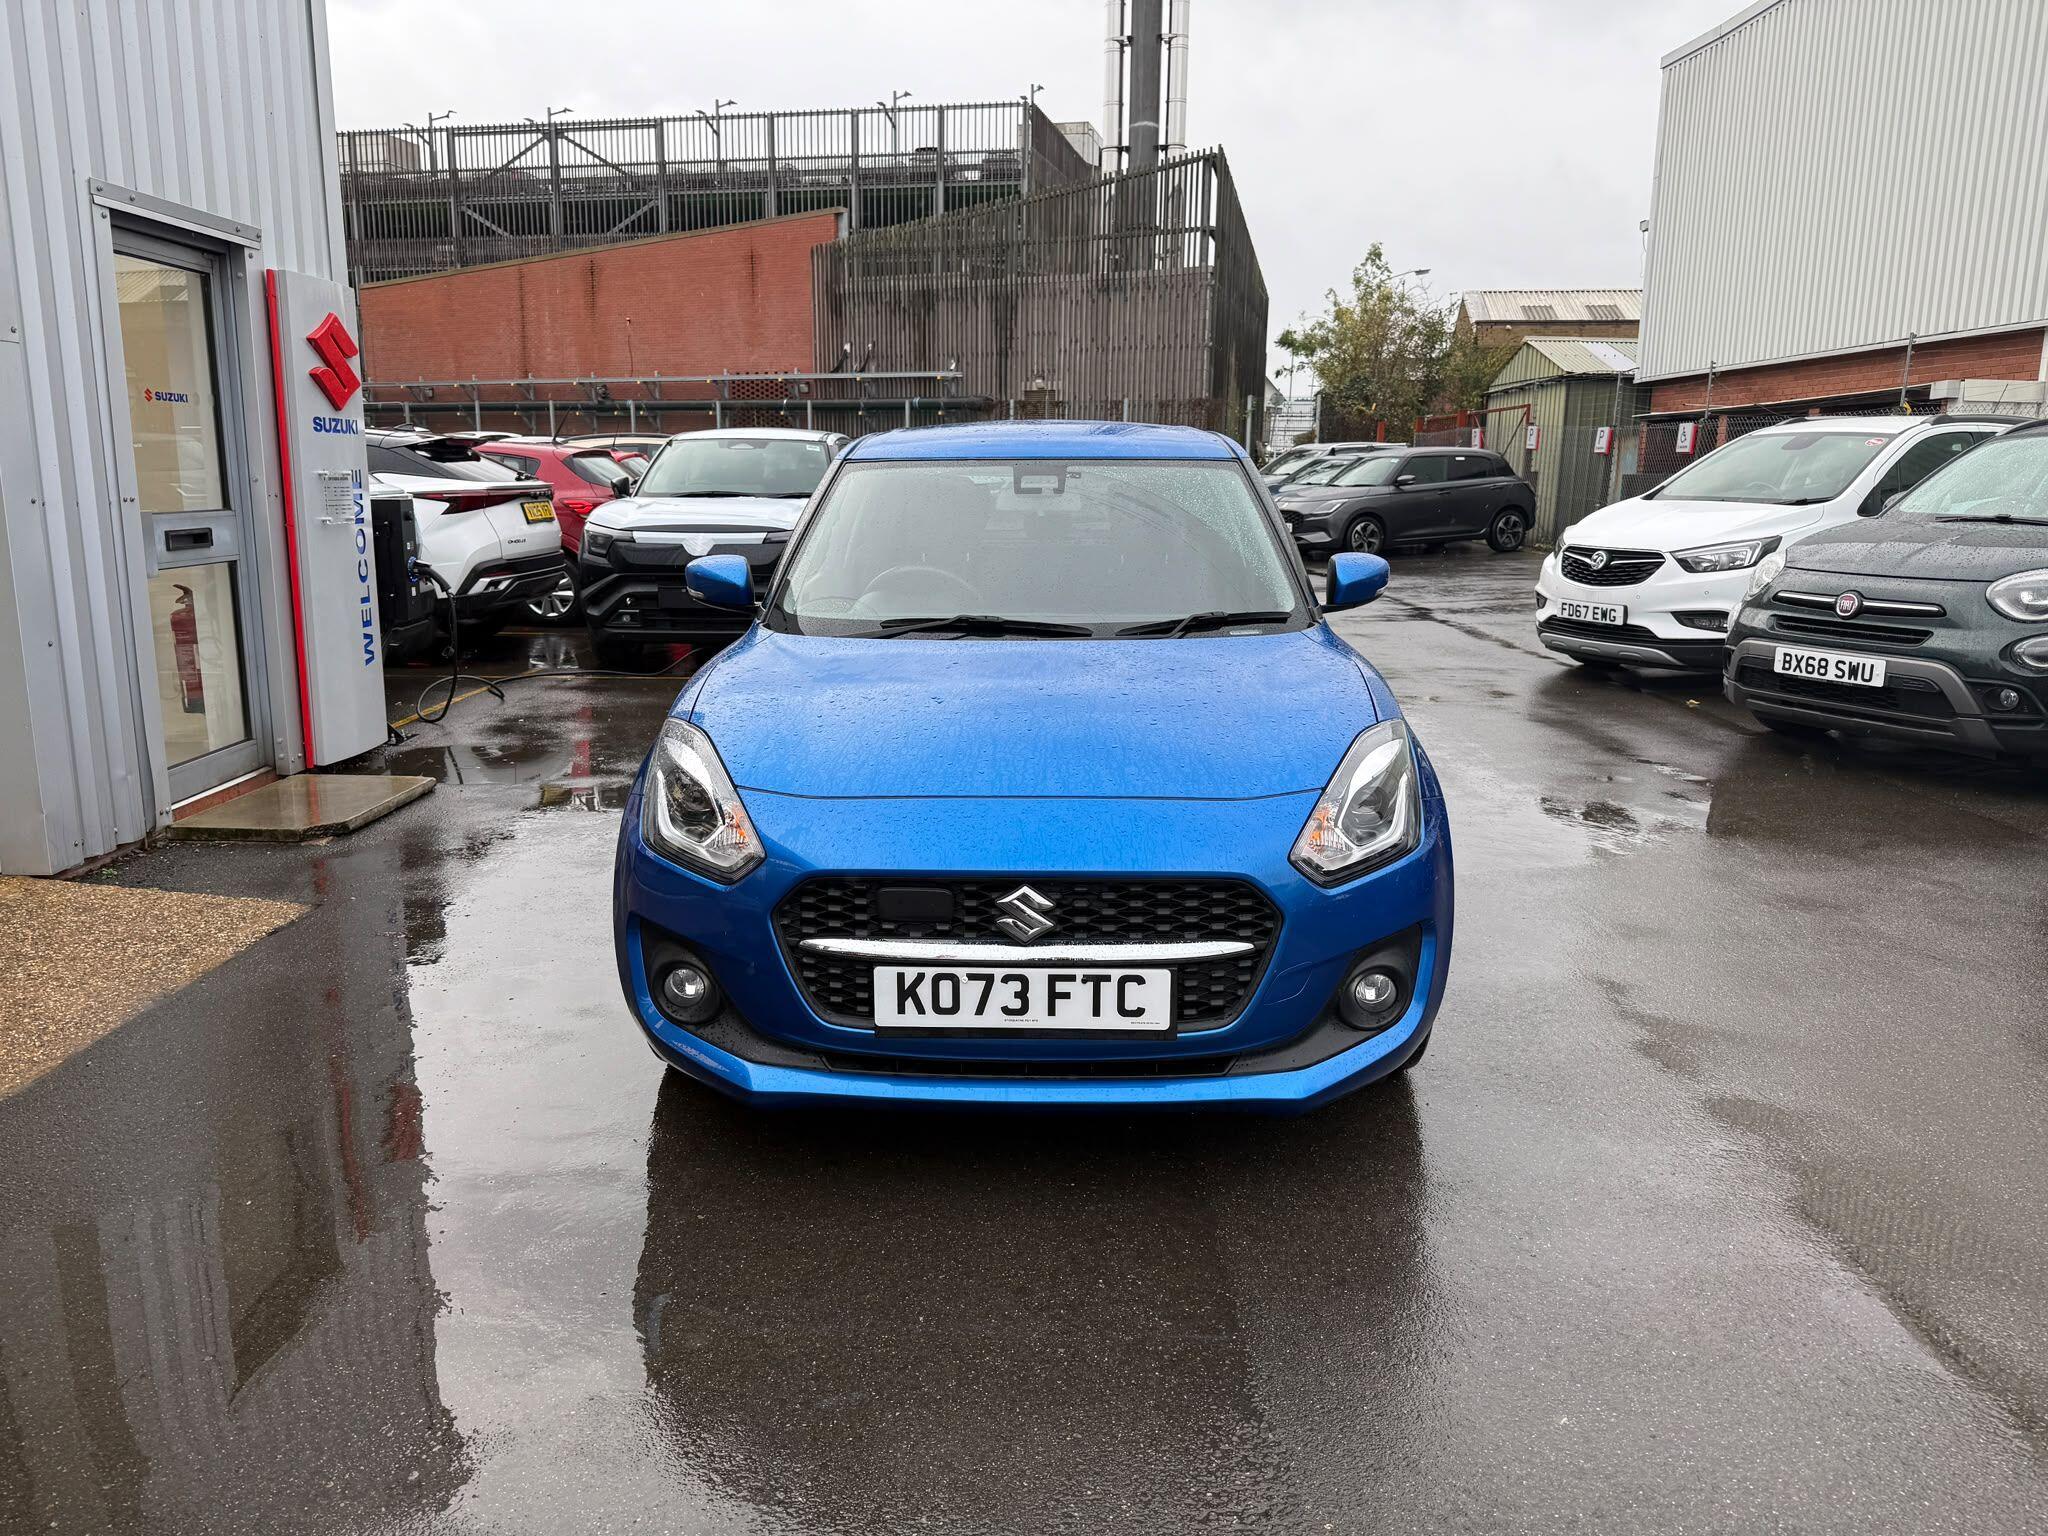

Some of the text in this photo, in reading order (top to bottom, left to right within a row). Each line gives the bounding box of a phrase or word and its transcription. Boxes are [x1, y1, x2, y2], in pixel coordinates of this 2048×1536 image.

[155, 391, 189, 403] SUZUKI
[313, 416, 359, 435] SUZUKI
[351, 469, 375, 666] WELCOME
[1561, 602, 1616, 622] FD67 EWG
[1840, 600, 1854, 611] FIAT
[1782, 652, 1875, 682] BX68 SWU
[896, 971, 1147, 1018] KO73 FTC
